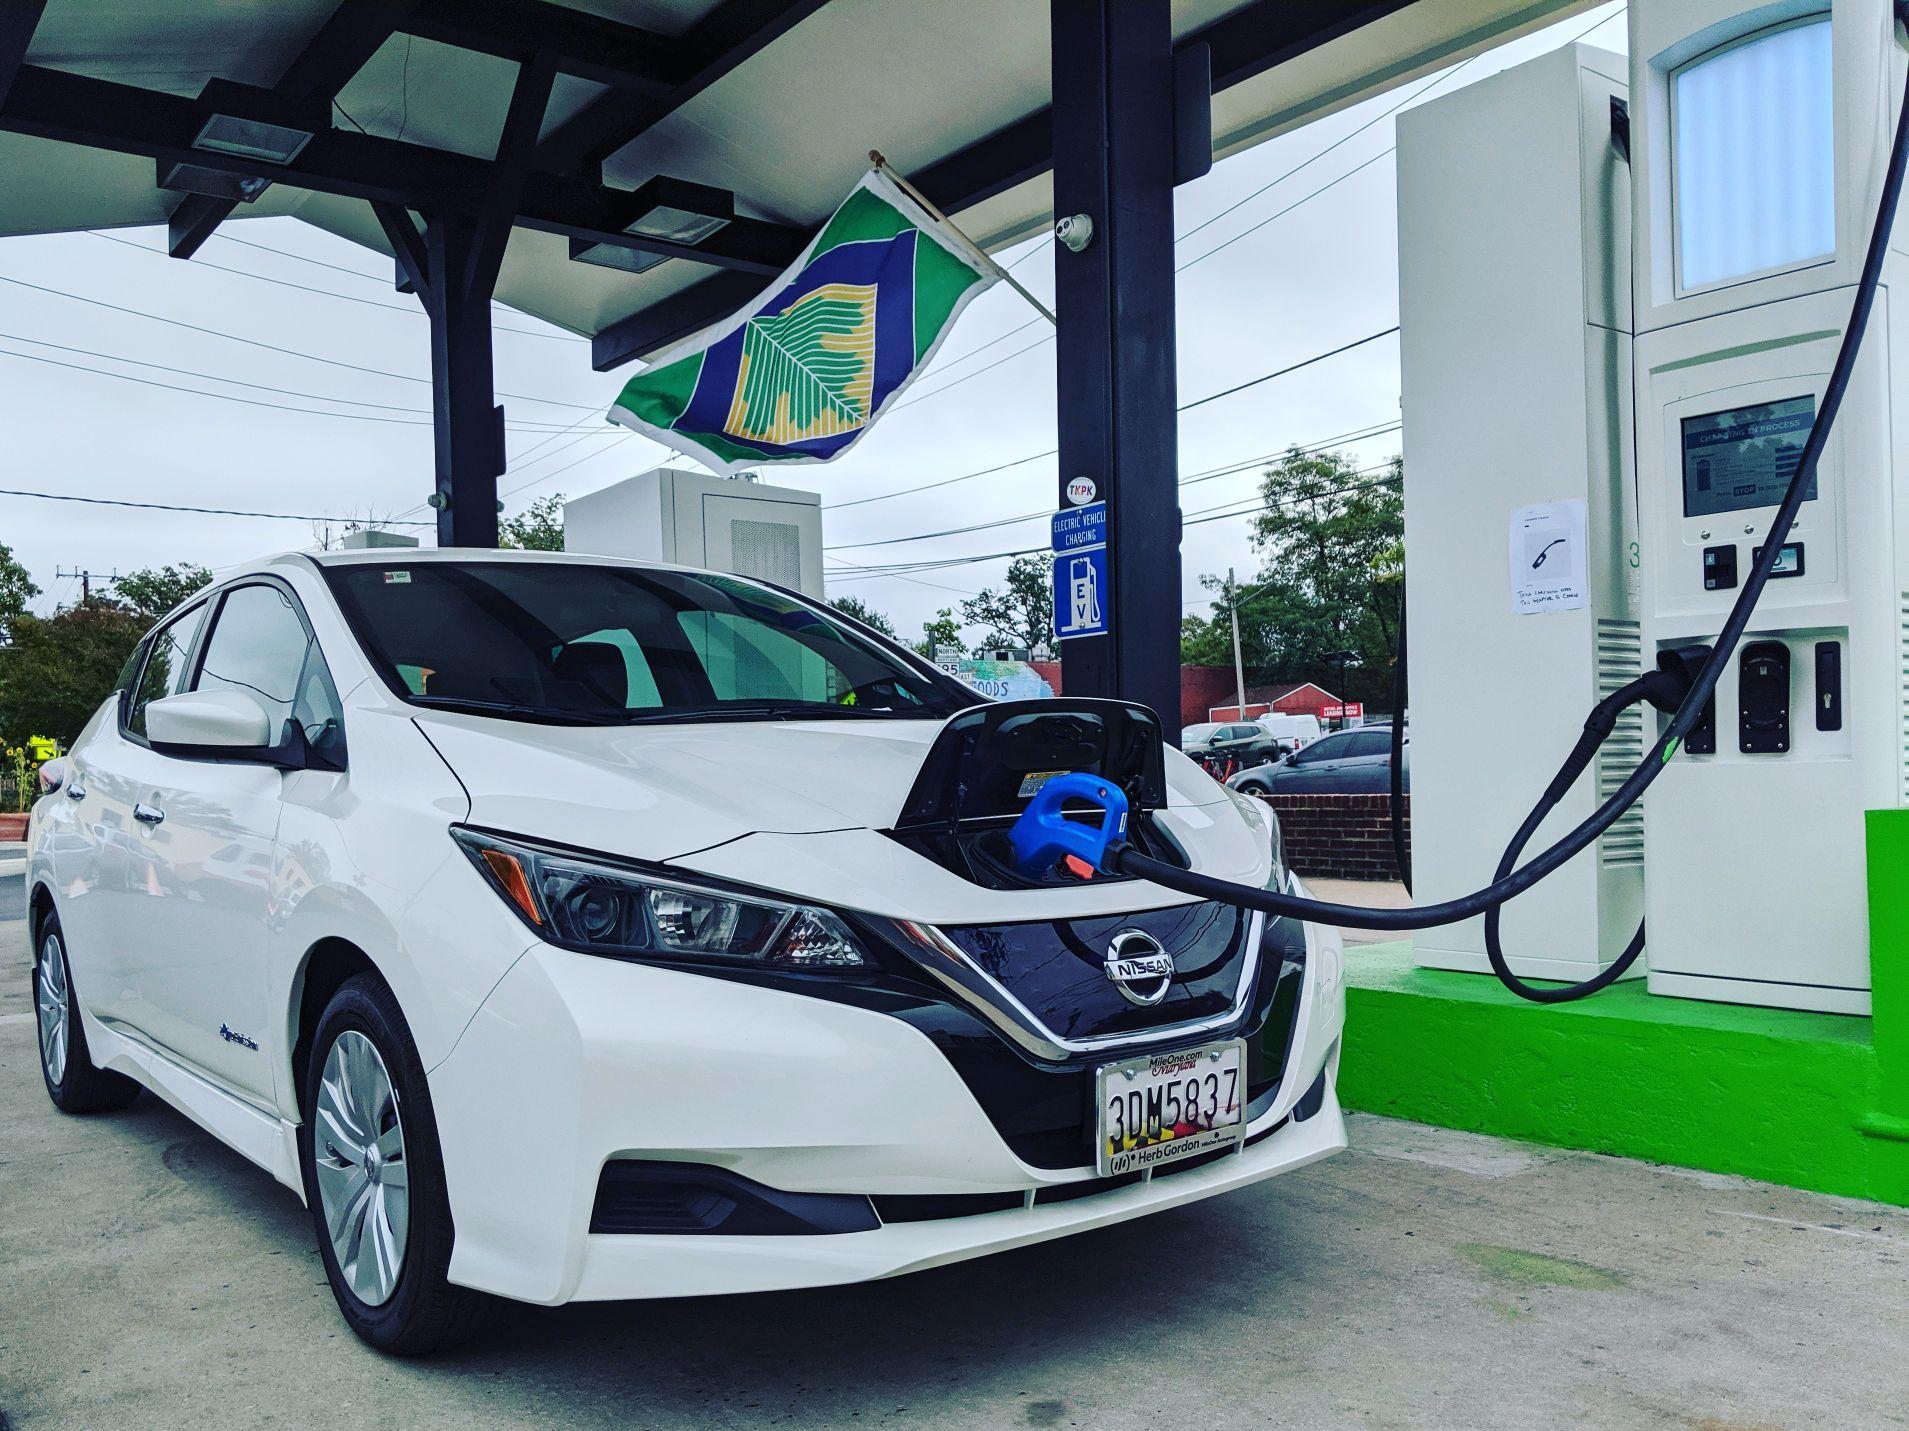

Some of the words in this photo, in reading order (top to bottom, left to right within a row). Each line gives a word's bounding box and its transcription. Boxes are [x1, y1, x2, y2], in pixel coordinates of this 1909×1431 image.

[1760, 419, 1801, 433] PROCESS
[1069, 484, 1094, 496] TKPK
[1735, 486, 1755, 495] STOP
[1054, 515, 1081, 533] ELECTRIC
[1065, 529, 1097, 546] CHARGING
[1117, 958, 1172, 976] NISSAN
[1148, 1050, 1203, 1069] MileOne.com
[1108, 1067, 1239, 1145] 3DM5837
[1138, 1147, 1163, 1164] Herb
[1163, 1139, 1200, 1157] Gordon
